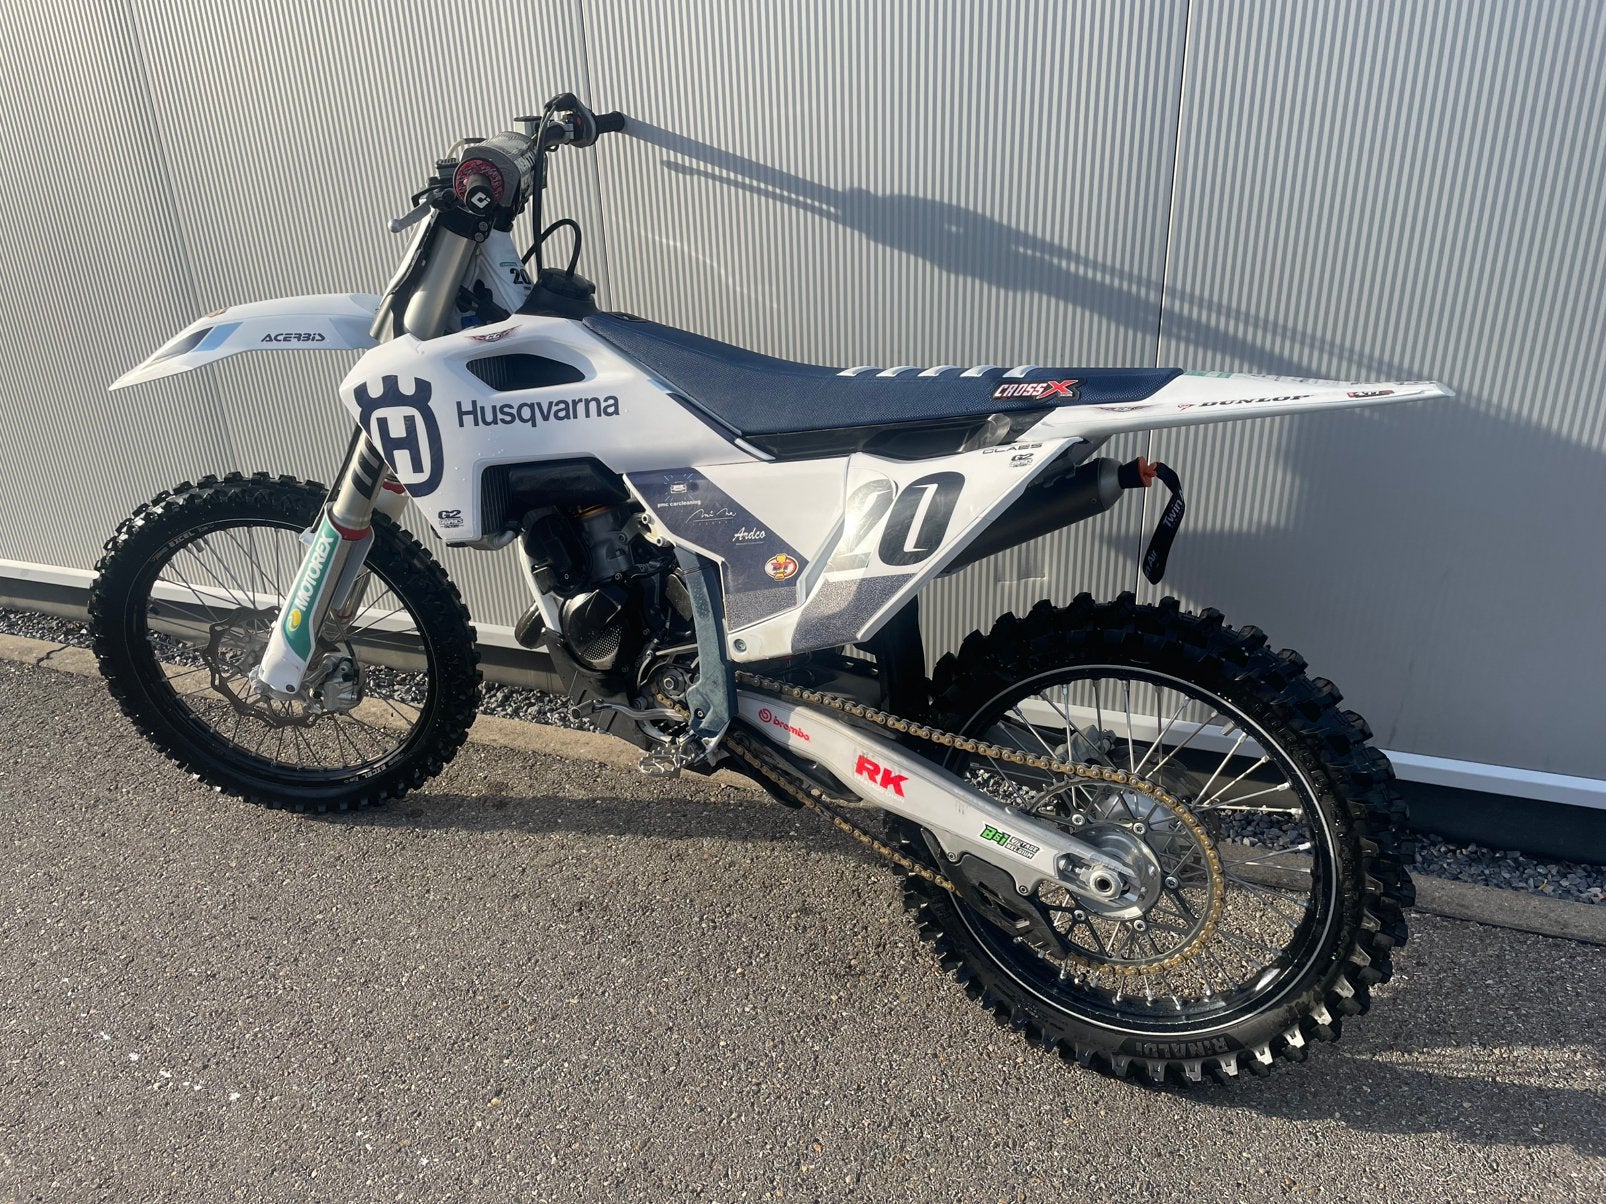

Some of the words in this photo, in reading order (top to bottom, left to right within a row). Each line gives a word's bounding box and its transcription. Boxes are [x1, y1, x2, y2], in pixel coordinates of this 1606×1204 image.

[456, 395, 620, 428] Husqvarna
[1198, 395, 1314, 407] DUNLOP
[822, 467, 966, 574] 20
[1162, 498, 1184, 528] Twin
[732, 527, 766, 542] Ardco
[295, 531, 335, 611] MOTOREX
[772, 715, 811, 742] brembo
[855, 754, 910, 798] RK
